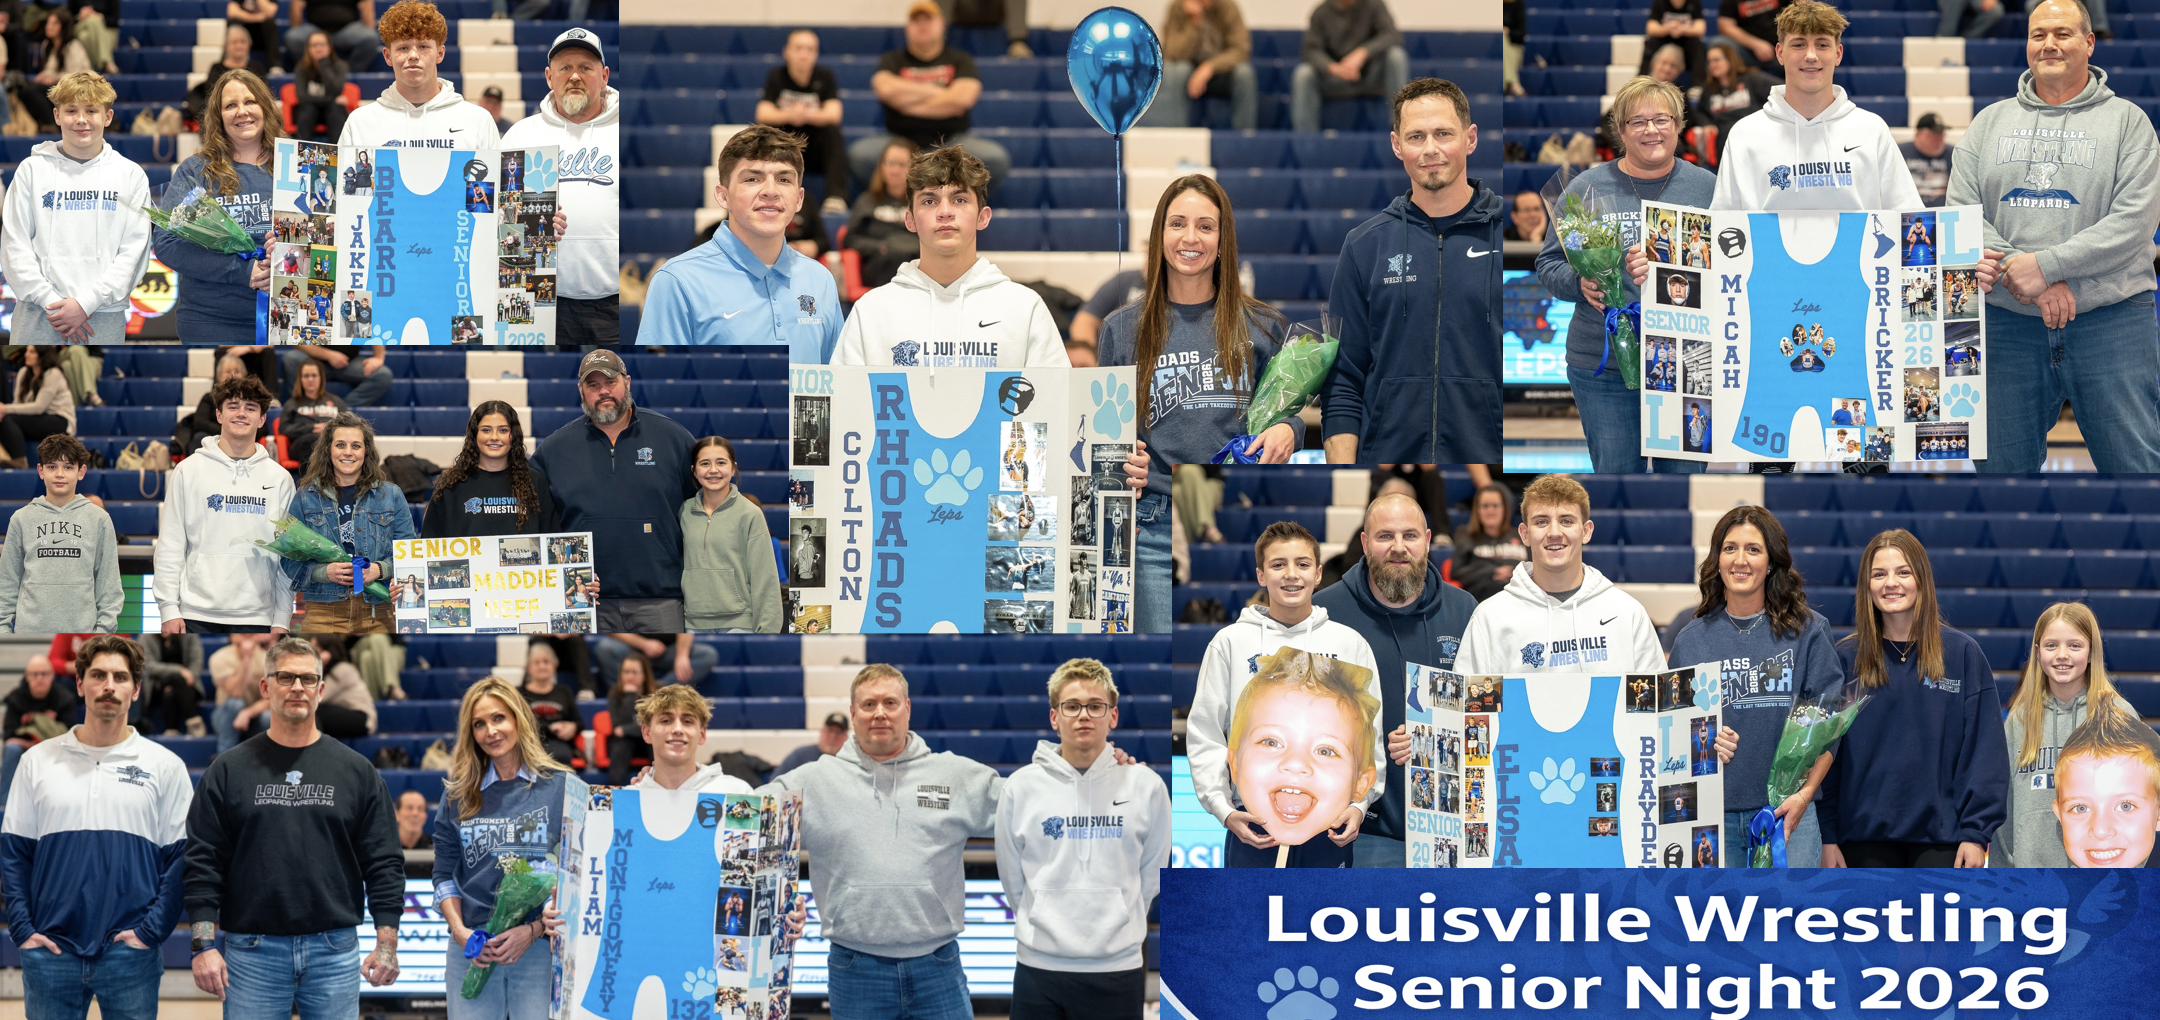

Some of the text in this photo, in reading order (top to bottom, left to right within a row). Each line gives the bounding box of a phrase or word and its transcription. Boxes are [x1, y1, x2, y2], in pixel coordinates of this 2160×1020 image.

[2012, 128, 2086, 138] LOUISVILLE
[1996, 136, 2098, 170] WRESTLING
[1792, 162, 1852, 177] LOUISVLLE
[1793, 174, 1853, 189] WRESTLNG
[64, 189, 118, 202] LOUISVLLE
[64, 199, 117, 212] WRESTING
[2008, 197, 2071, 209] LEOPARDS
[1602, 211, 1641, 222] BRICK
[373, 166, 397, 297] BEARD
[1939, 210, 1980, 265] L
[349, 215, 366, 289] JAKE
[453, 209, 470, 316] SENIOR
[1383, 274, 1417, 285] WRESTING
[1644, 309, 1711, 336] SENIOR
[1720, 274, 1742, 388] MICAH
[1874, 266, 1893, 411] BRICKER
[1155, 350, 1200, 369] OADS
[1645, 393, 1680, 452] L
[1741, 416, 1786, 454] 190
[225, 494, 266, 506] LOUISVILLE
[225, 503, 266, 515] WRESTLING
[874, 384, 910, 629] RHOADS
[839, 431, 863, 601] COLTON
[36, 521, 82, 539] NIKE
[38, 549, 80, 557] FOOTBALL
[394, 537, 482, 560] SENIOR
[474, 568, 558, 591] MADDIE
[484, 597, 541, 619] NEFF
[1720, 657, 1751, 671] ASS
[1663, 756, 1686, 775] Leps
[254, 784, 335, 799] LOUISVILLE
[917, 784, 950, 795] LOUISVILLE
[254, 798, 335, 807] LEOPARDS WRESTLING
[917, 799, 950, 810] WRESTLING
[1495, 744, 1523, 868] ELSA
[1638, 736, 1657, 868] BRAYDE
[460, 817, 510, 827] MONTGOMERY
[1066, 815, 1124, 828] LOUISVILLE
[1407, 810, 1463, 839] SENIOR
[582, 857, 603, 936] LIAM
[600, 828, 634, 1014] MONTGOMERY
[671, 998, 711, 1020] 132
